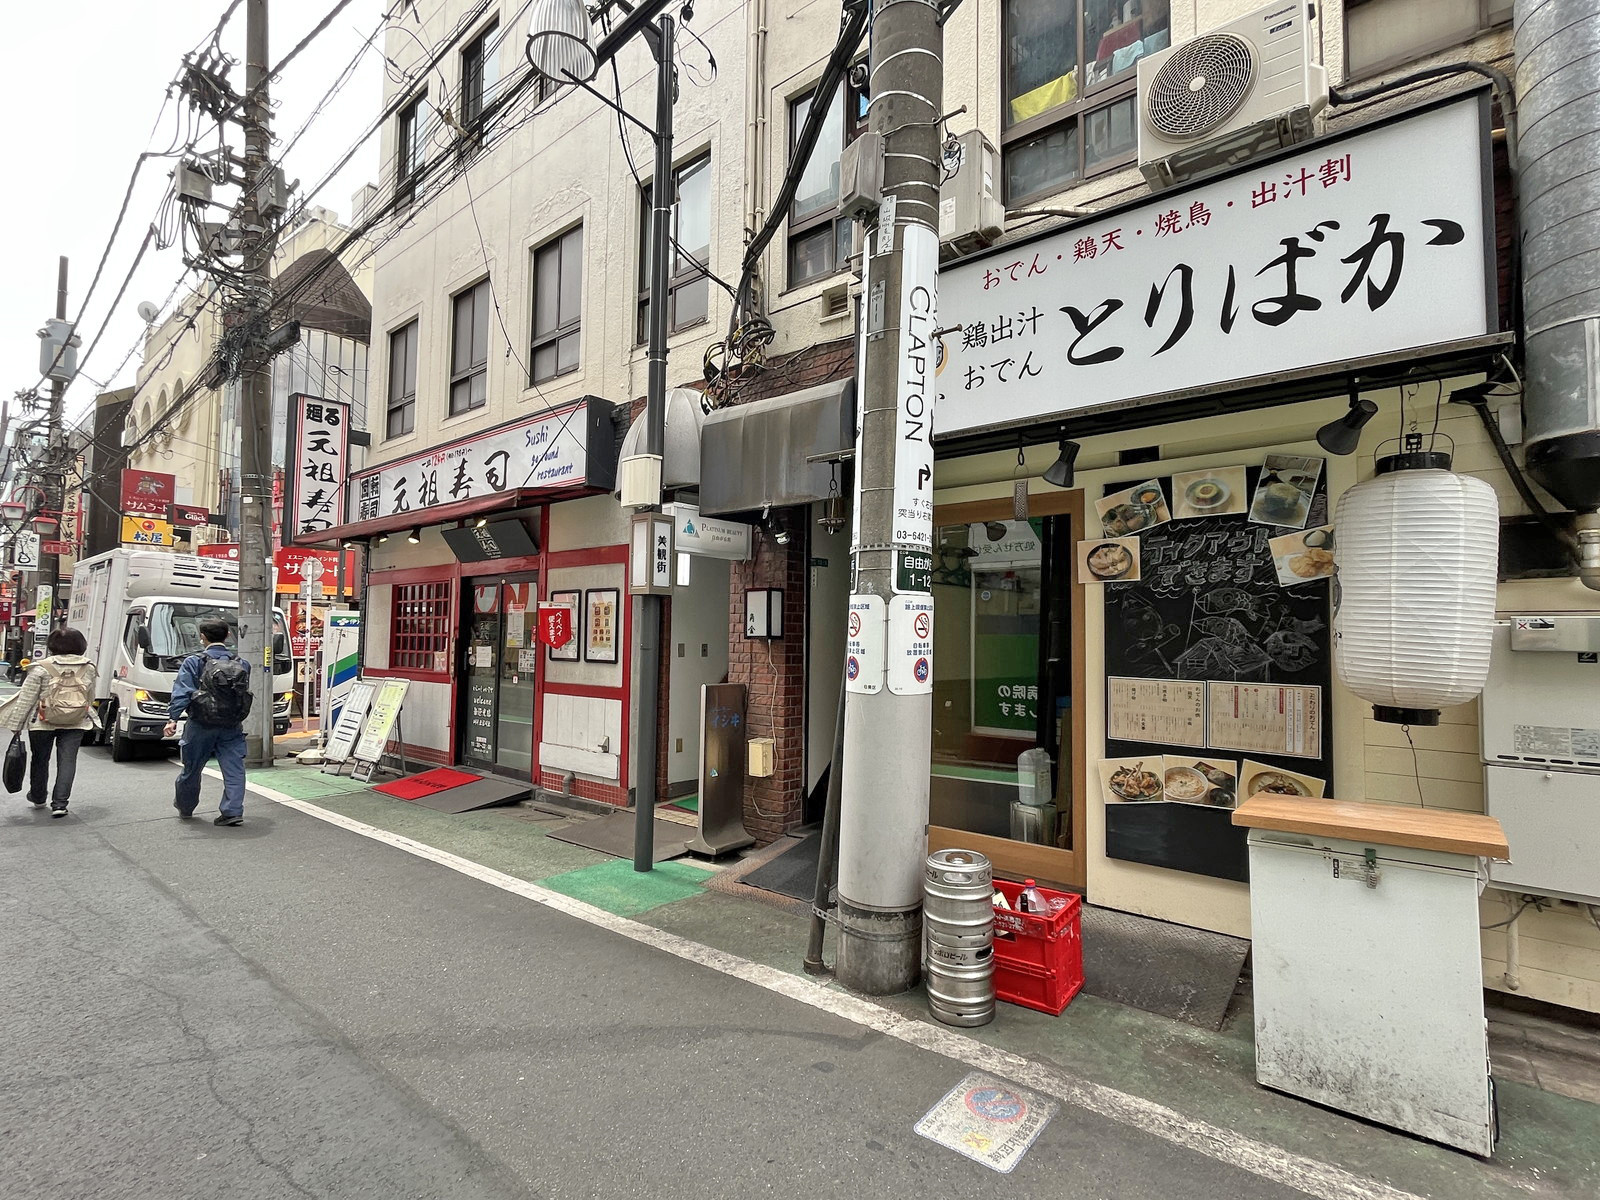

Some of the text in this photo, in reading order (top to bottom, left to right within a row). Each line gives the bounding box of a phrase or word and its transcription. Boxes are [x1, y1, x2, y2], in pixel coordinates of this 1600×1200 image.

[1263, 4, 1297, 21] Panasonic
[982, 153, 1352, 291] おでん・鶏天・焼鳥・出汁割
[1058, 213, 1465, 366] とりばか
[962, 307, 1045, 352] 鶏出汁
[904, 285, 932, 442] CLAPTON
[964, 351, 1043, 389] おでん
[525, 425, 549, 448] Sushi
[391, 450, 511, 514] 元祖寿司
[536, 462, 574, 481] restaurant
[133, 531, 163, 544] 松屋
[656, 535, 669, 574] 美観街
[555, 610, 563, 637] ペイペイ
